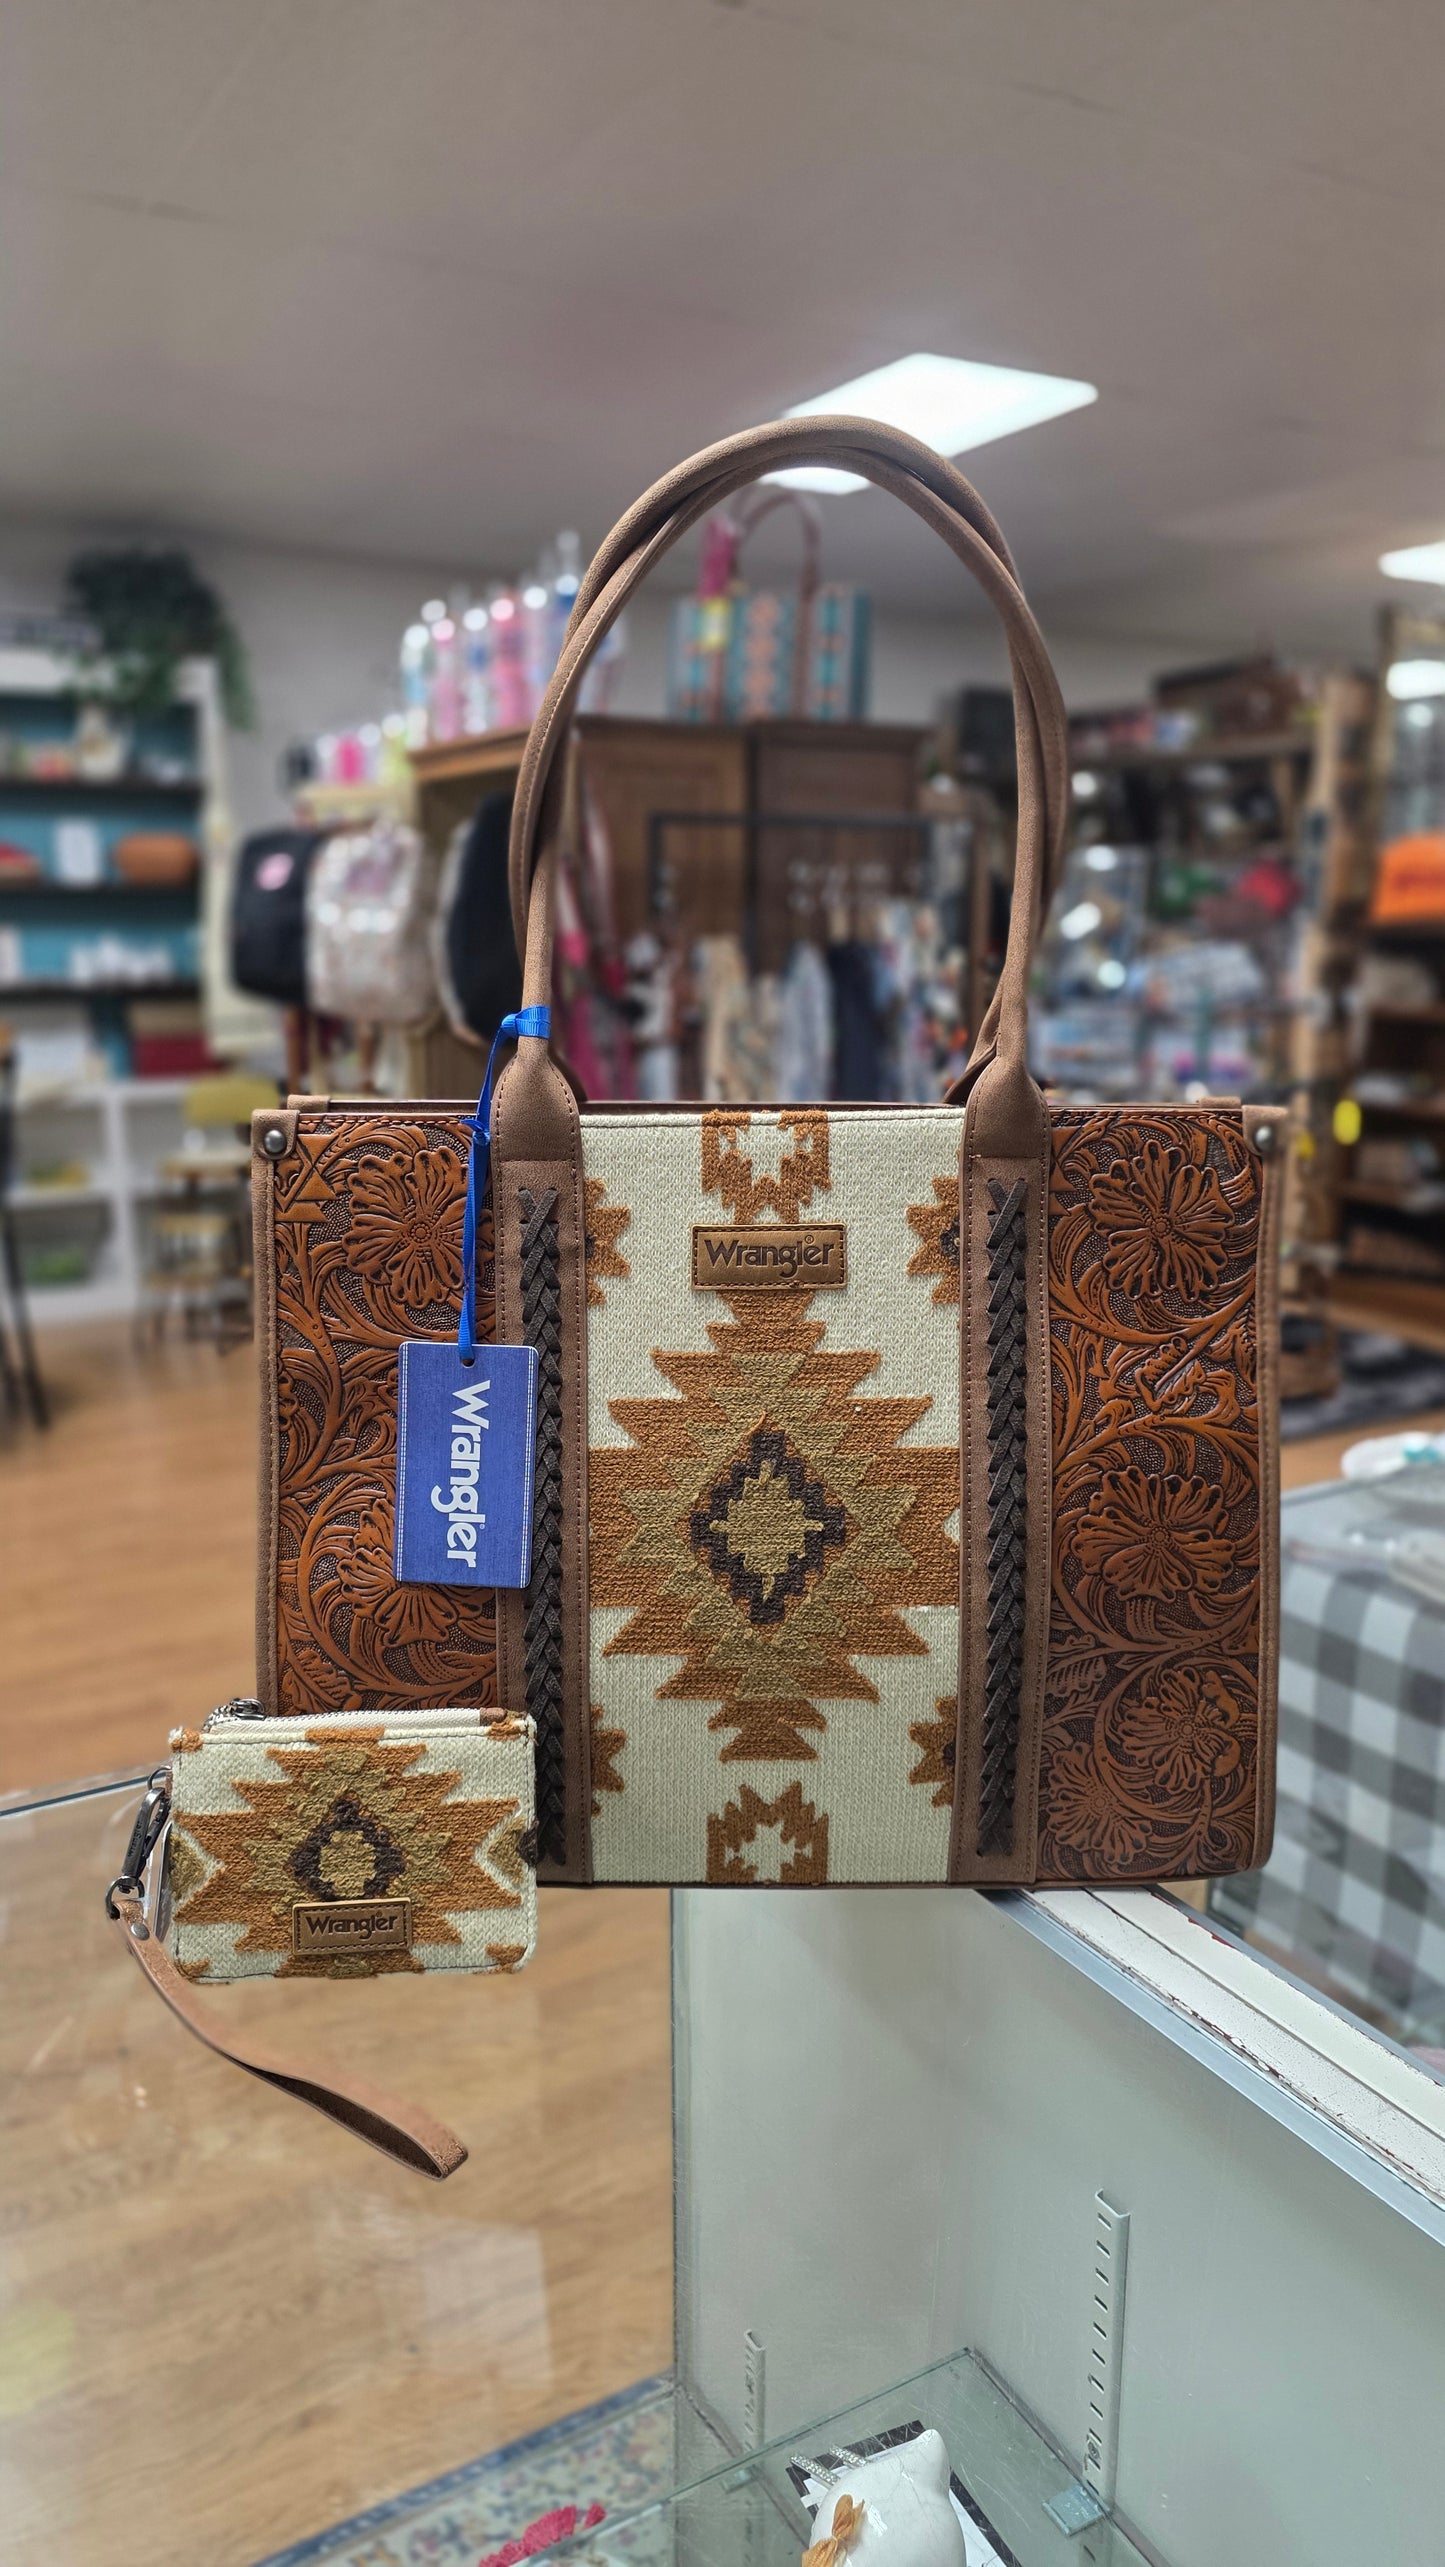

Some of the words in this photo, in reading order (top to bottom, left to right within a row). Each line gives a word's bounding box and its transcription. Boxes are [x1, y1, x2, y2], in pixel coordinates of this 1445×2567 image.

[704, 1236, 835, 1278] Wrangler
[431, 1379, 491, 1568] Wrangler
[305, 1913, 398, 1940] Wrangler
